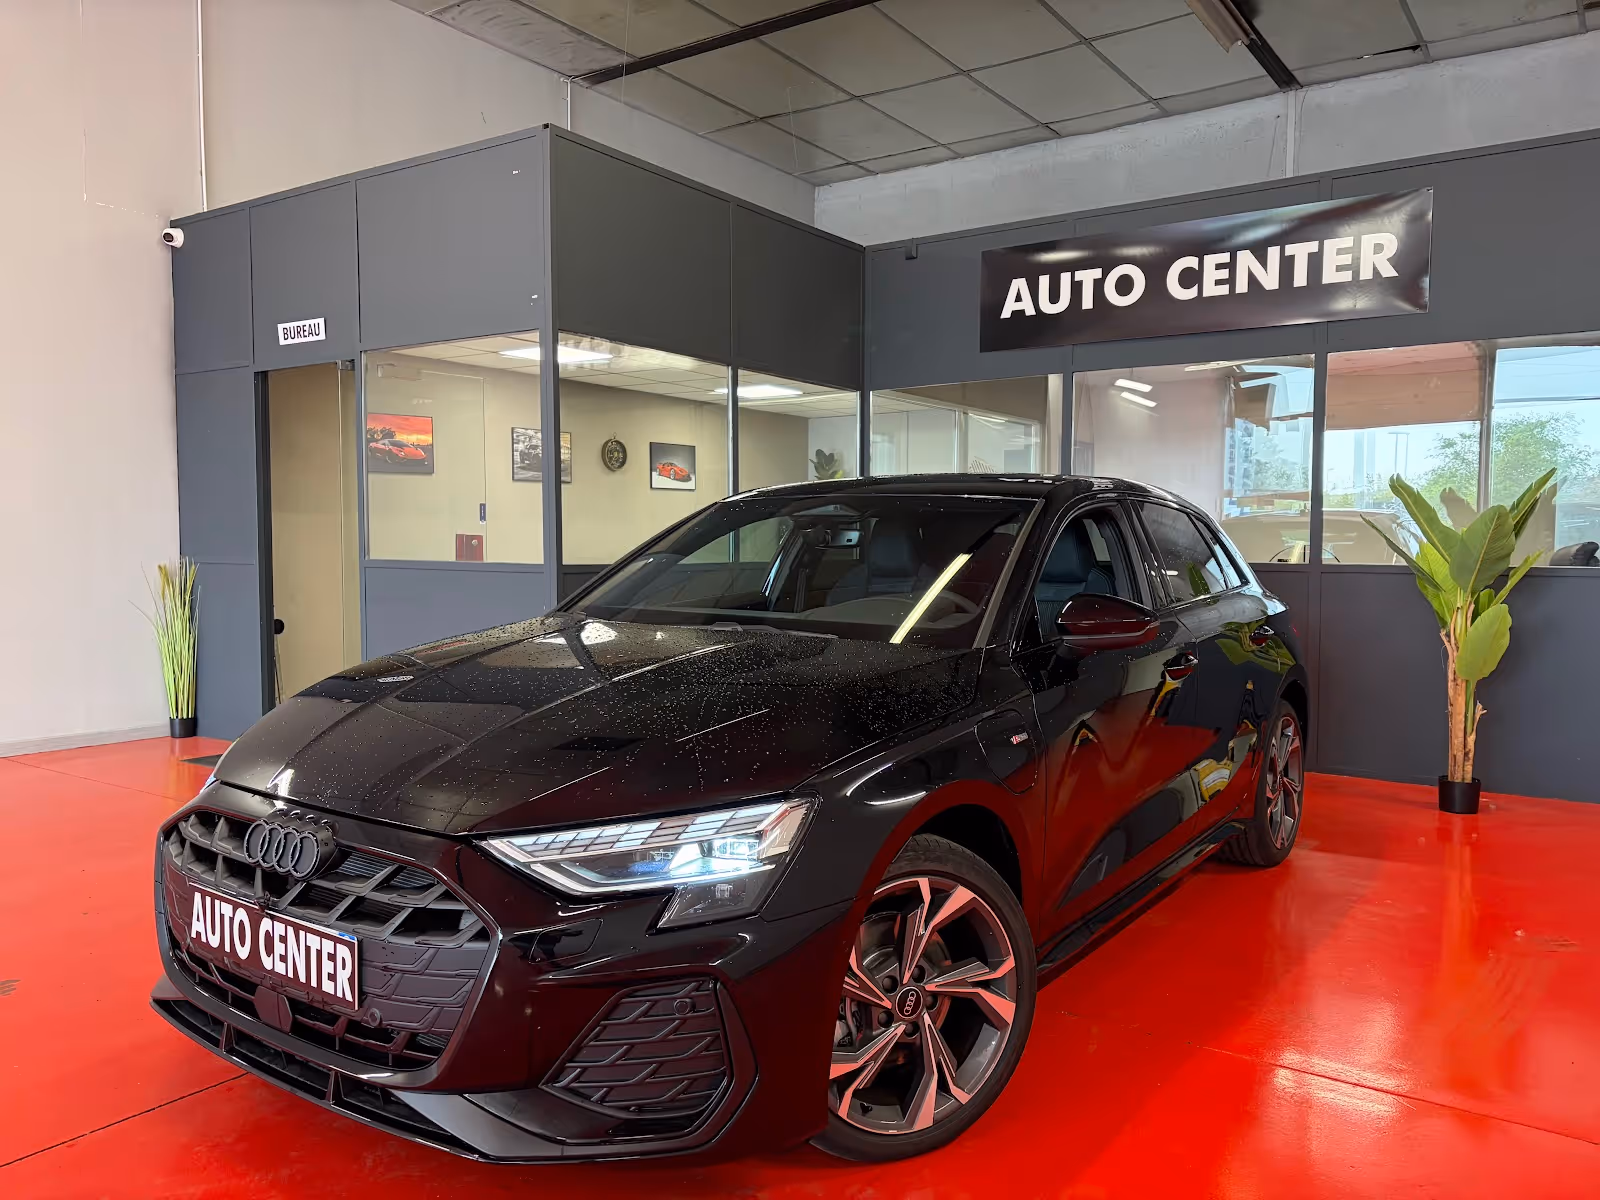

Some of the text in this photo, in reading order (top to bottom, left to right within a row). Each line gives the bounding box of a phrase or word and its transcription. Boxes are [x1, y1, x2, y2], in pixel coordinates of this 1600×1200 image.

[1000, 232, 1399, 319] AUTO CENTER
[282, 322, 321, 341] BUREAU
[191, 892, 354, 1002] AUTO CENTER
